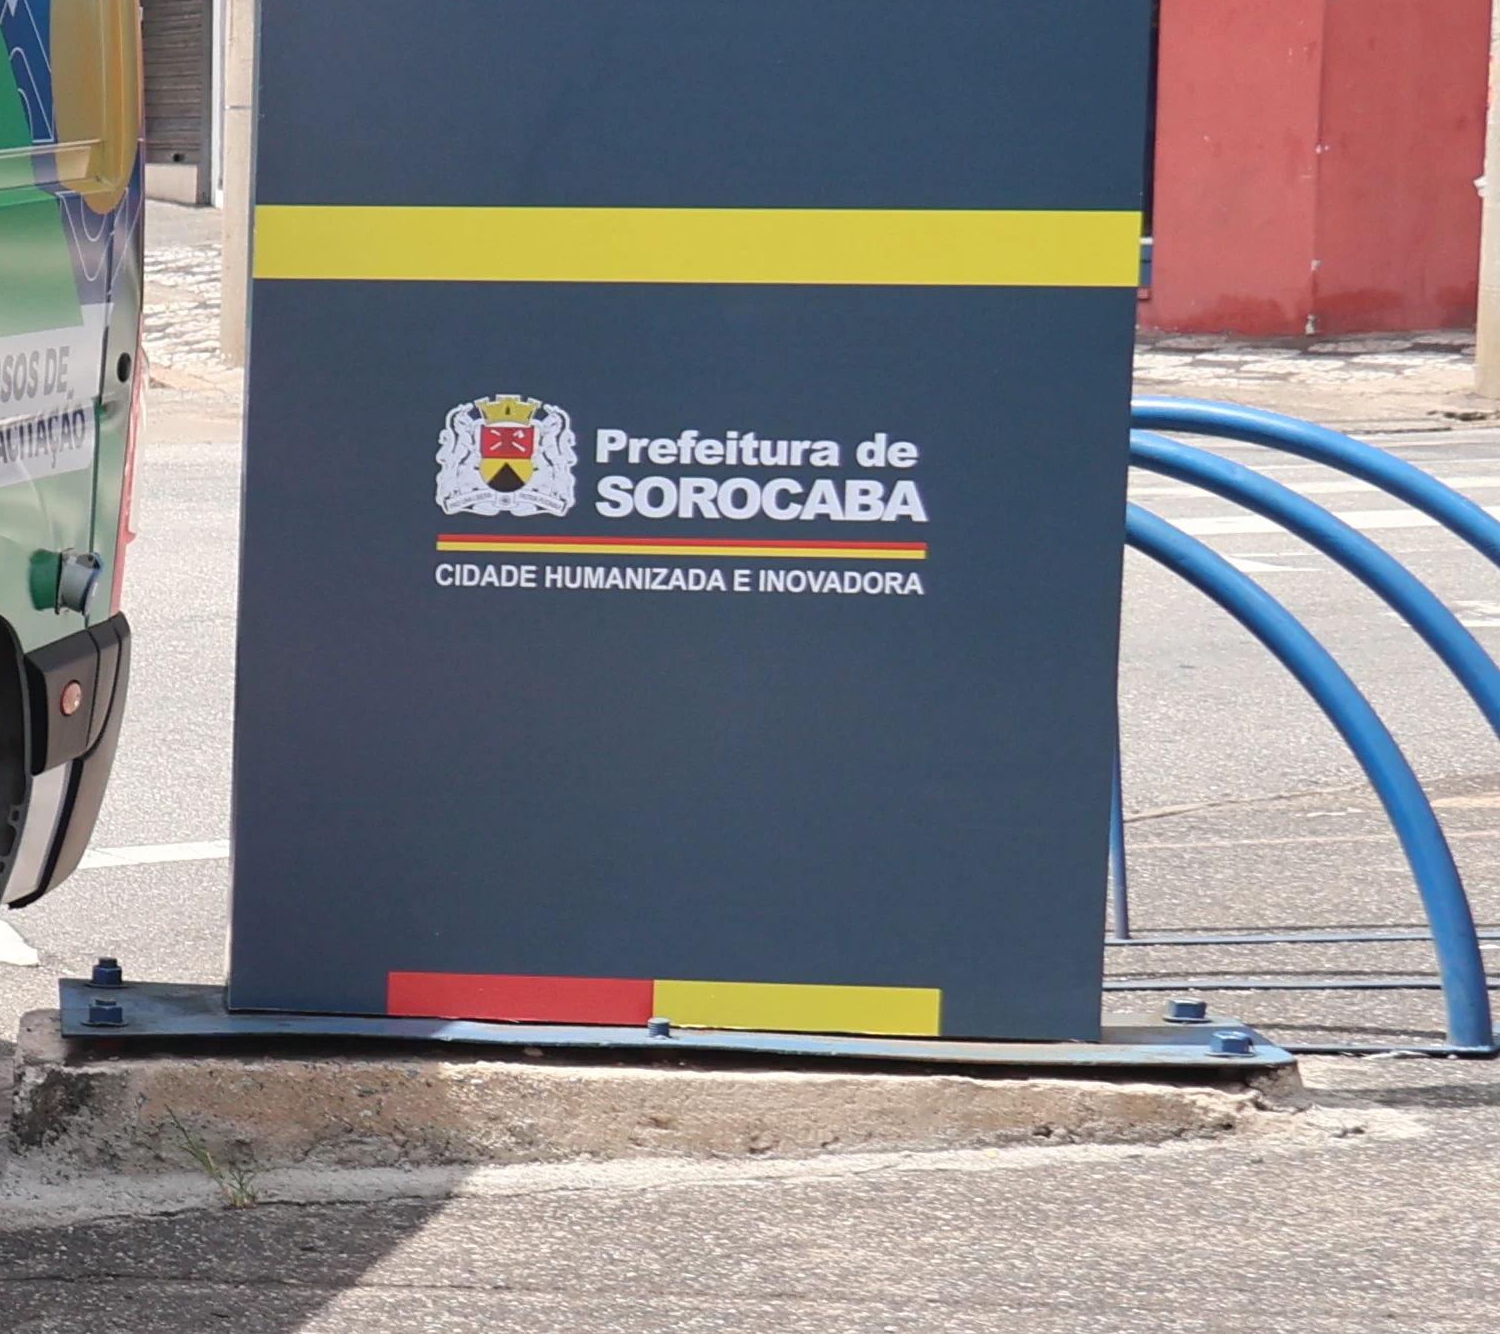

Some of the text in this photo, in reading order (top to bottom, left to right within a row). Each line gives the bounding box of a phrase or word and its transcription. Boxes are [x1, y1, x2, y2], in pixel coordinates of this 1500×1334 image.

[43, 346, 70, 396] DE
[595, 428, 918, 468] Prefeitura de
[595, 474, 928, 522] SOROCABA
[435, 563, 924, 596] CIDADE HUMANIZADA E INOVADORA
